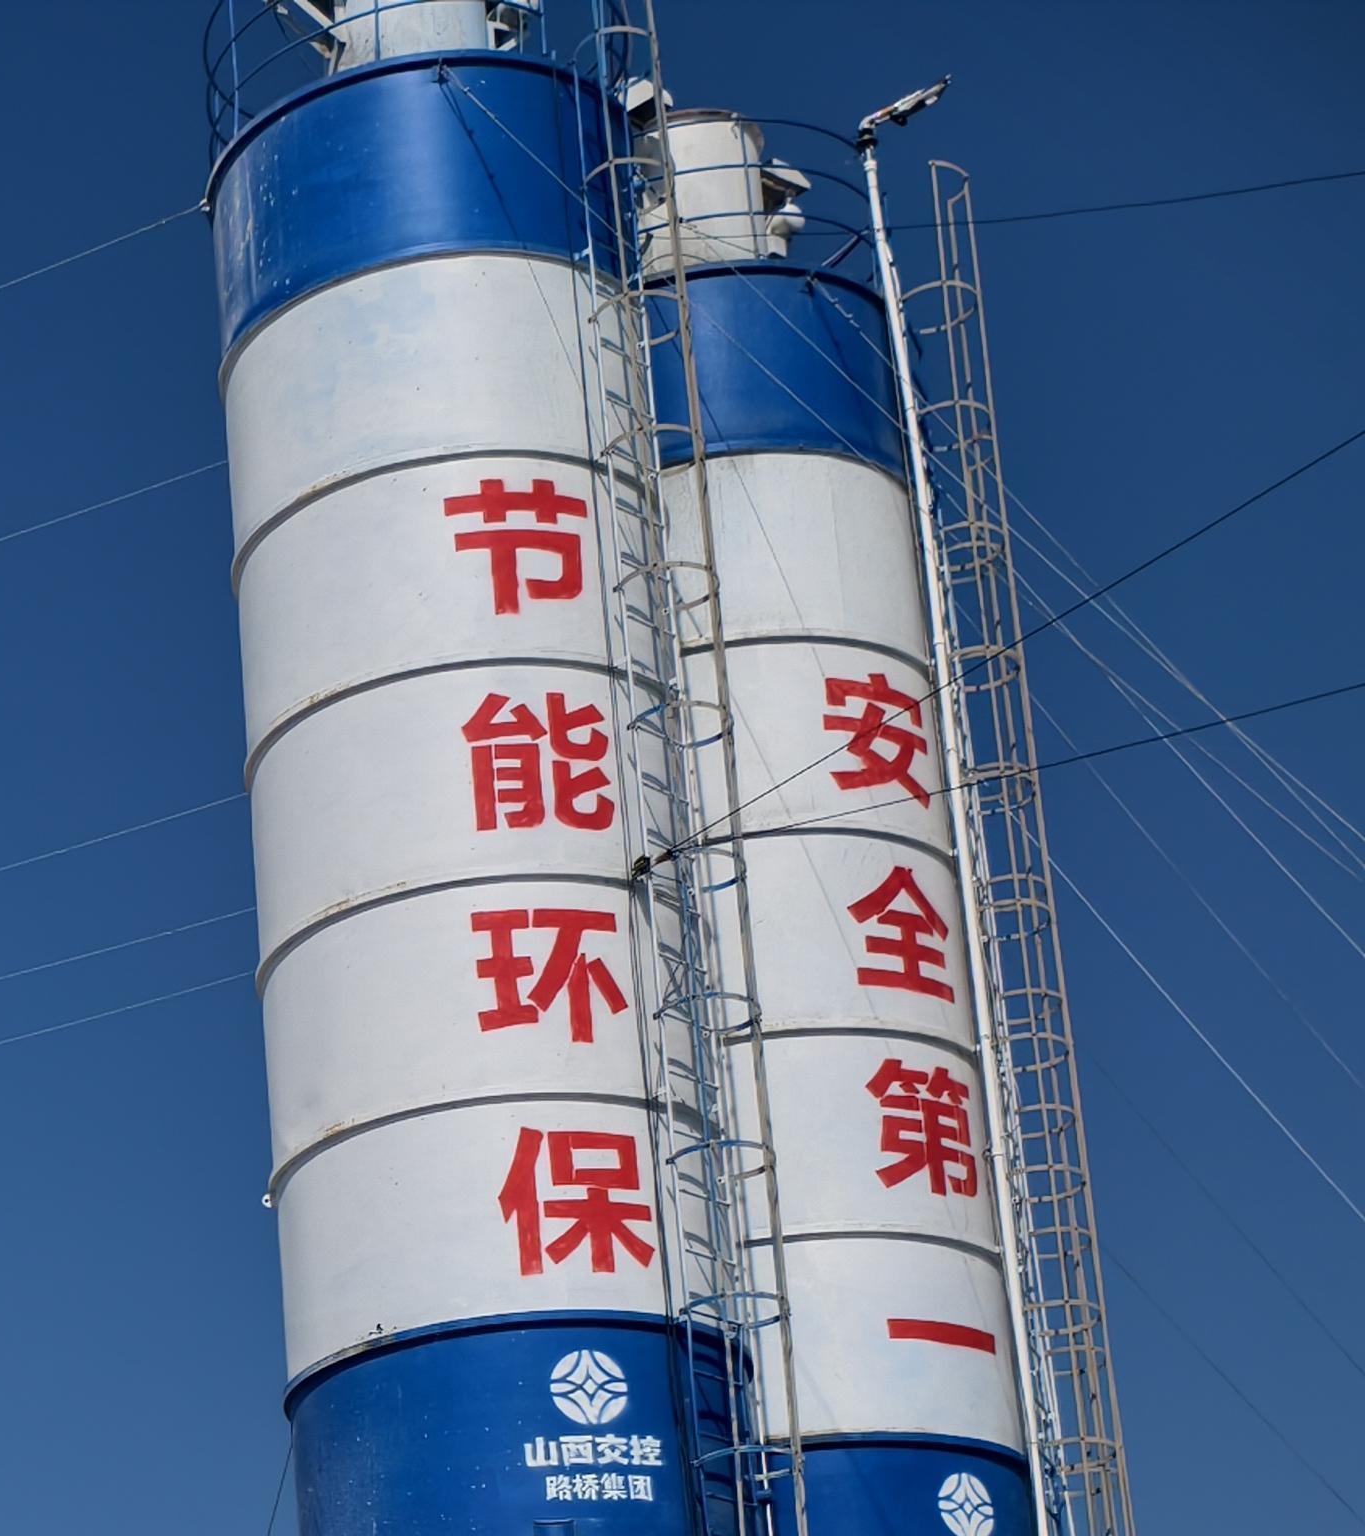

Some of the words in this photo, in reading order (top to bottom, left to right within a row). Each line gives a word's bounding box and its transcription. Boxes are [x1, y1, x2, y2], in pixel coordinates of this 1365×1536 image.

[444, 479, 655, 1276] 节能环保
[823, 673, 996, 1354] 安全第一
[524, 1433, 663, 1468] 山西交控
[545, 1472, 654, 1502] 路桥集团
